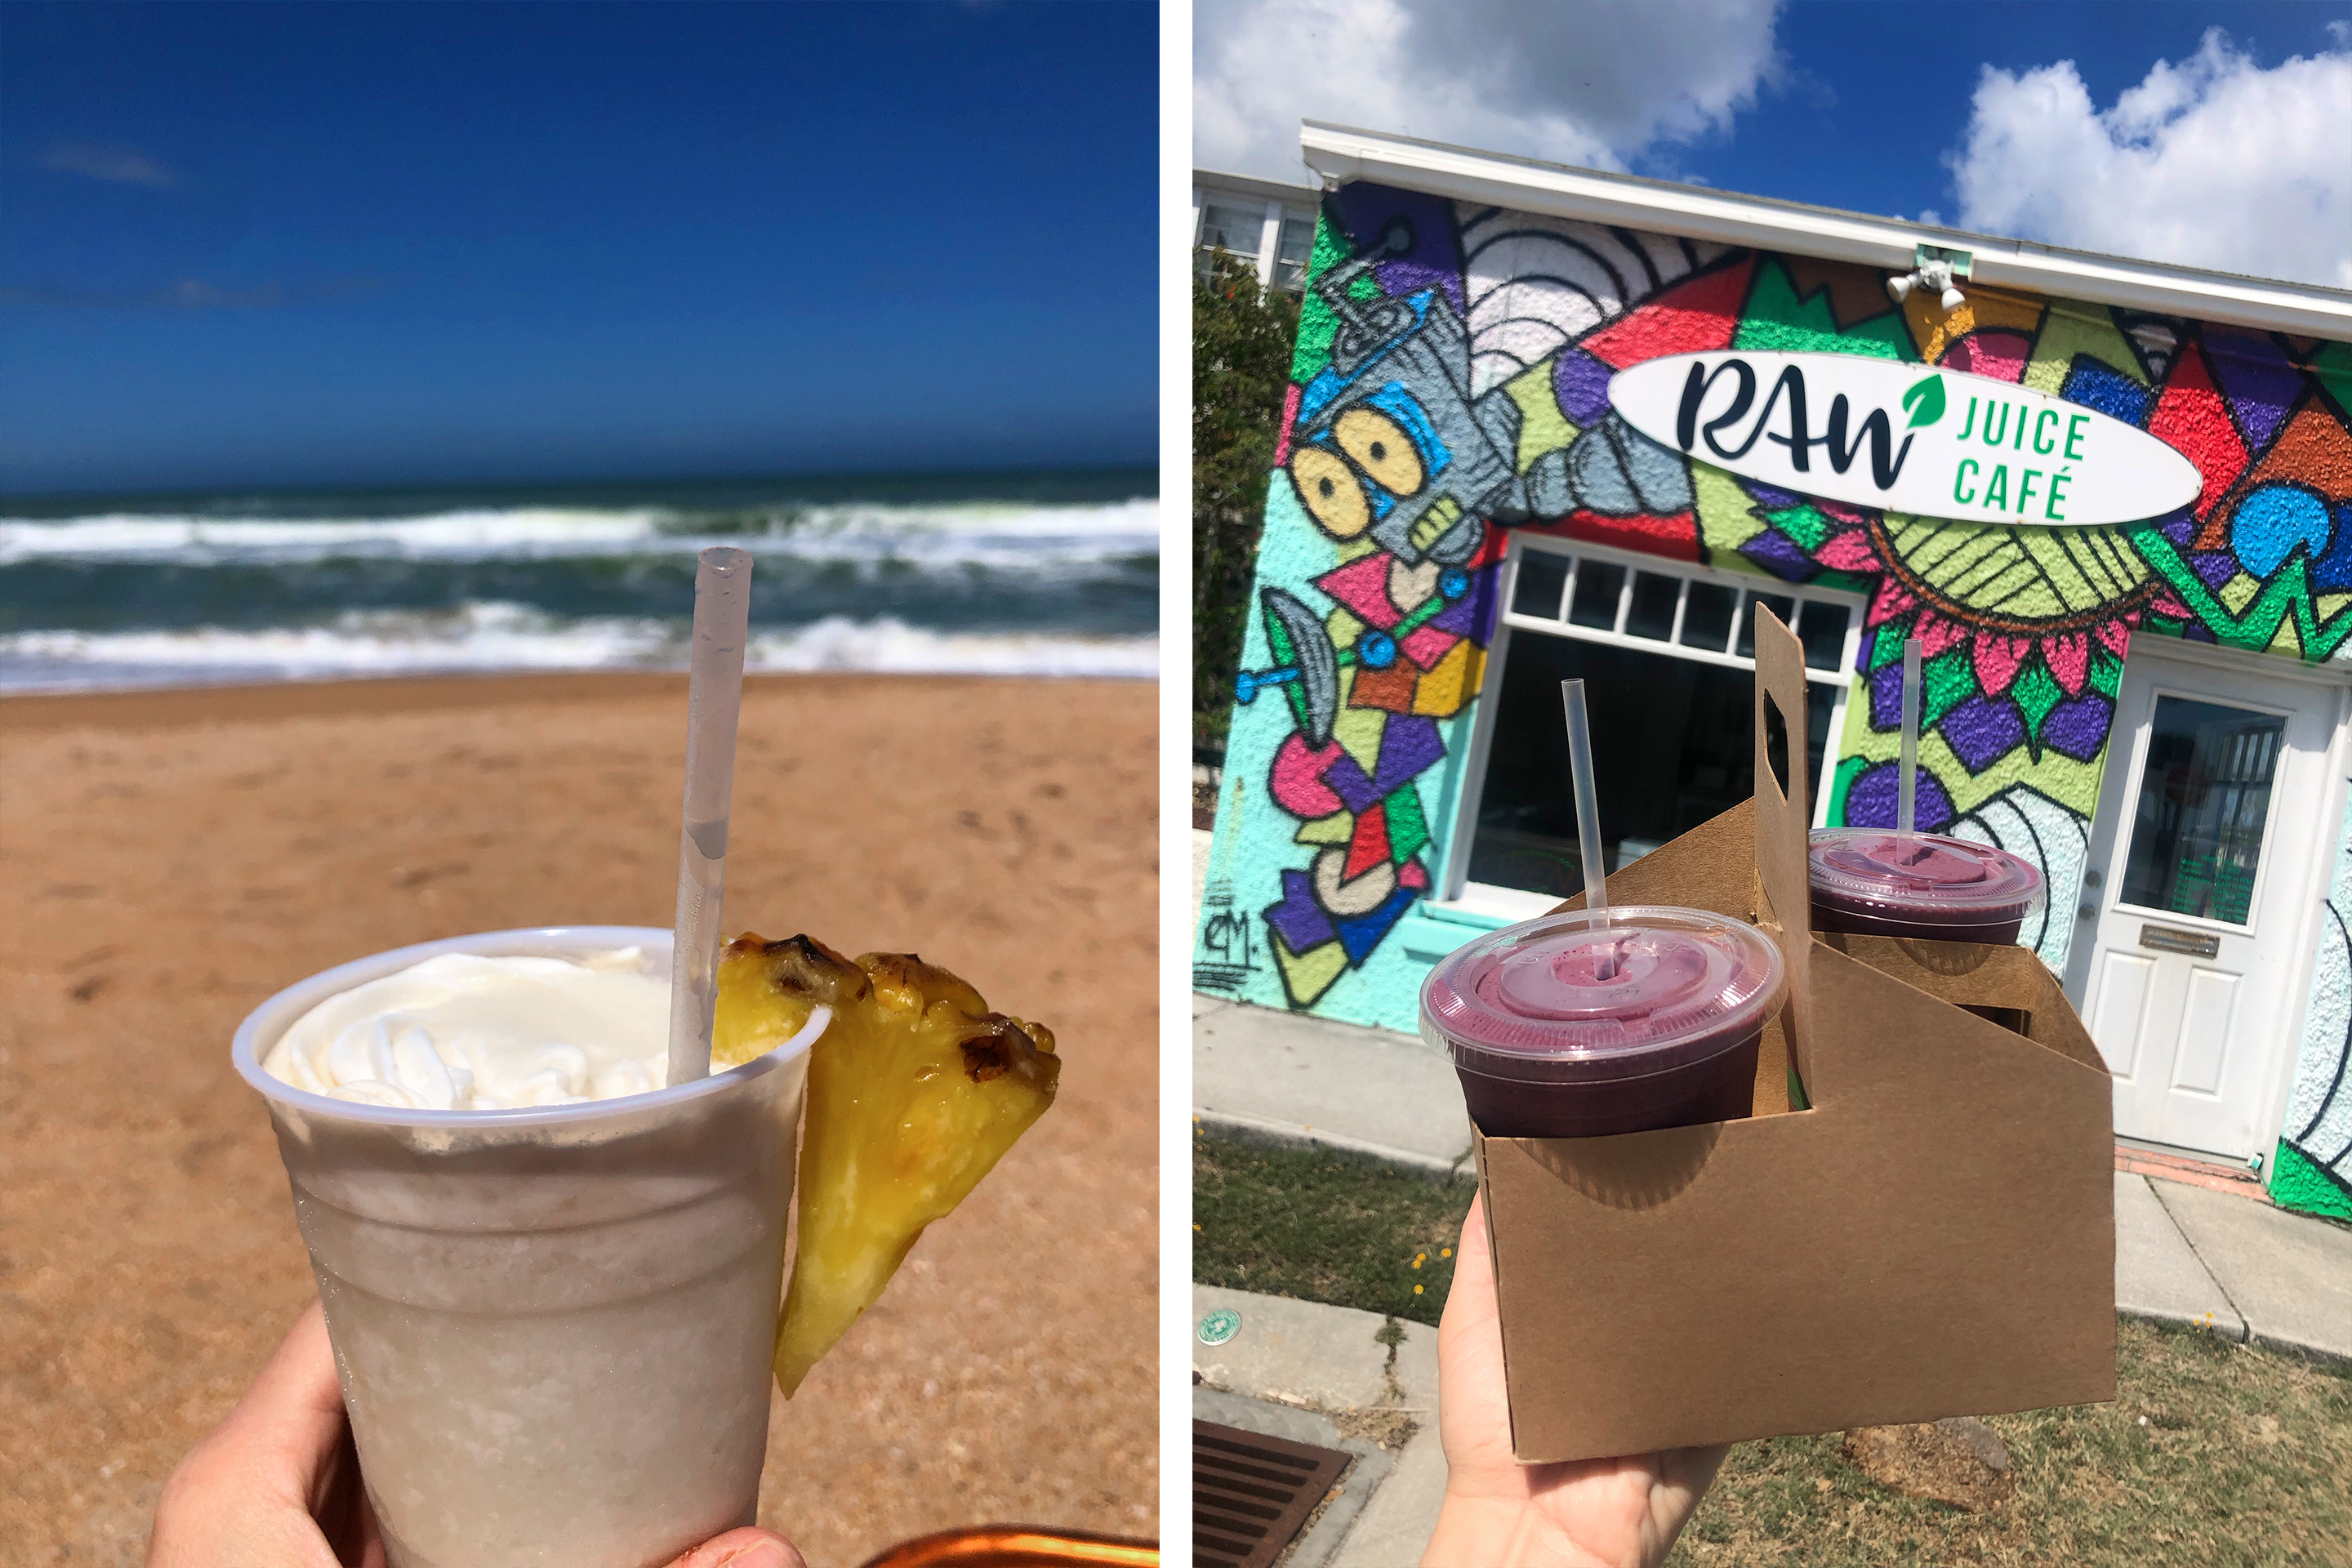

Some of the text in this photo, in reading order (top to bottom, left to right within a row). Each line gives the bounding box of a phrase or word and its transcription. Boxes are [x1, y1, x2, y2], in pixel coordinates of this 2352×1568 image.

[1675, 359, 1914, 491] RAW
[1957, 397, 2091, 461] JUICE
[1953, 458, 2073, 521] CAFÉ
